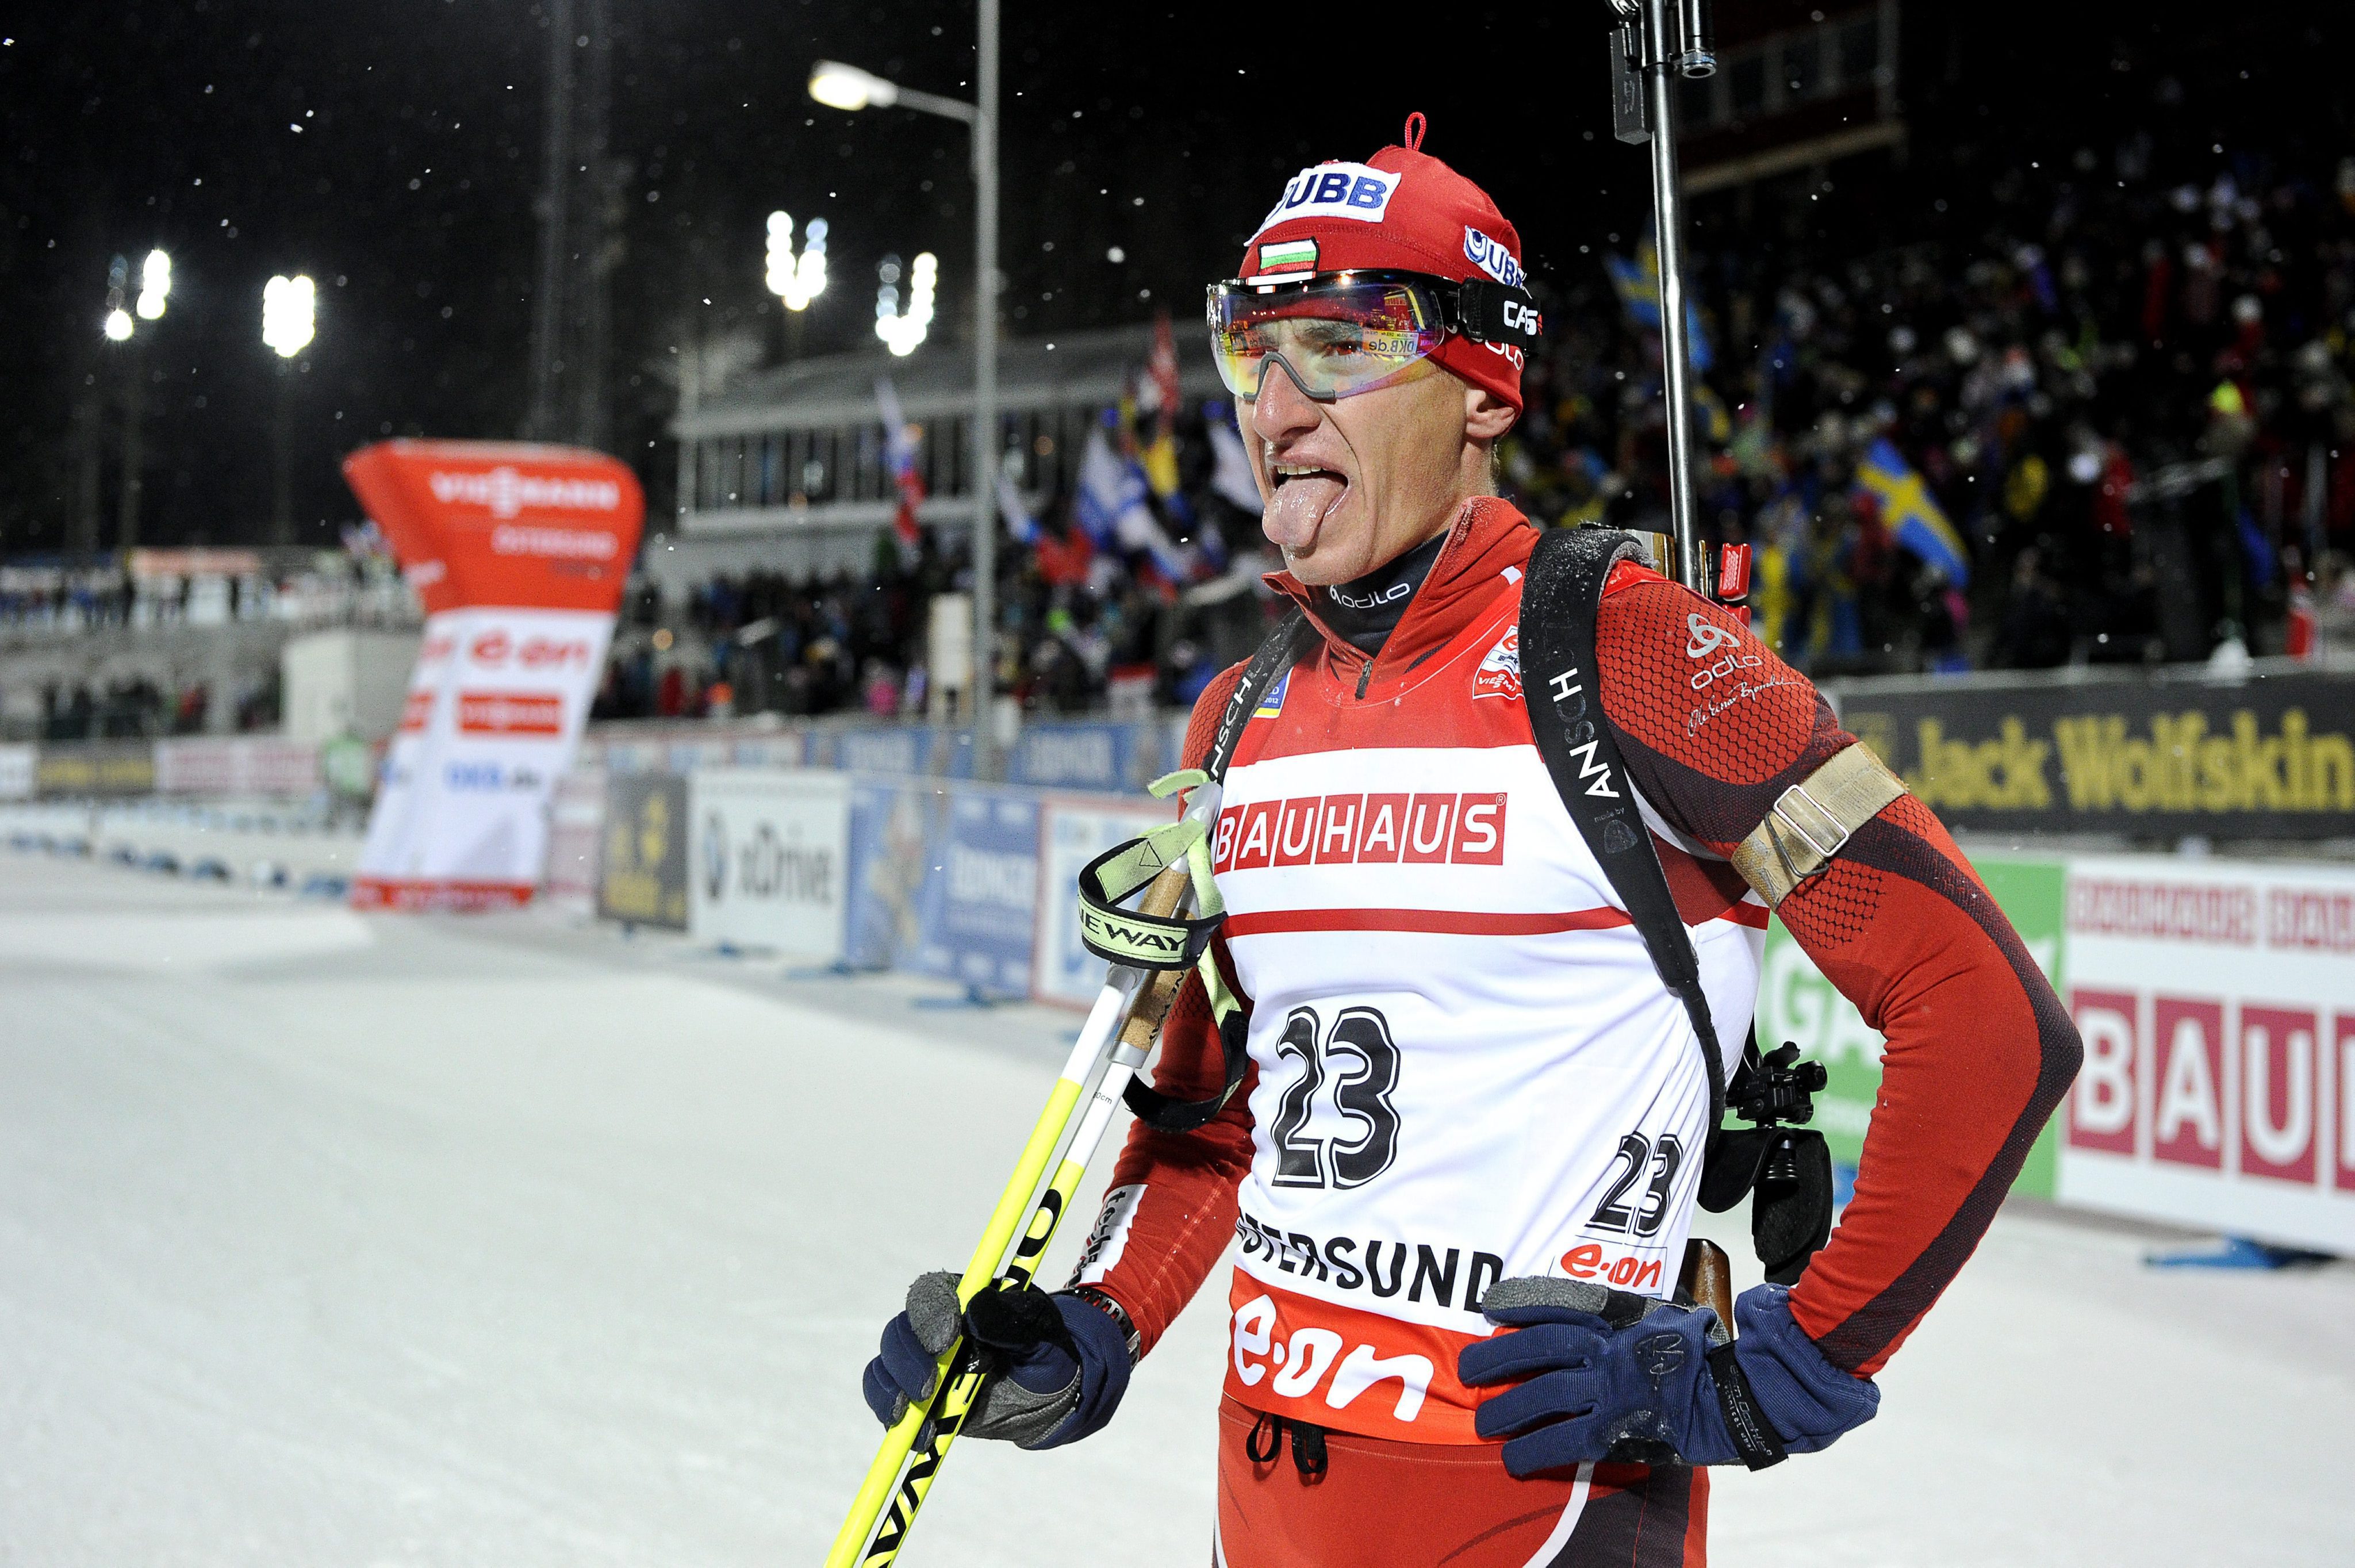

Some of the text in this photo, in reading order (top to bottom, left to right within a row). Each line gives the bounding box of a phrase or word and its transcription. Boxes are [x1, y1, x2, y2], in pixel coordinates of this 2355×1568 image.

[1286, 173, 1387, 209] UBB
[1904, 709, 2355, 814] Jack Wolfskin
[1215, 803, 1498, 864] BAUHAUS
[1271, 1006, 1401, 1190] 23
[2076, 1007, 2355, 1170] BAU
[1584, 1130, 1683, 1238] 23
